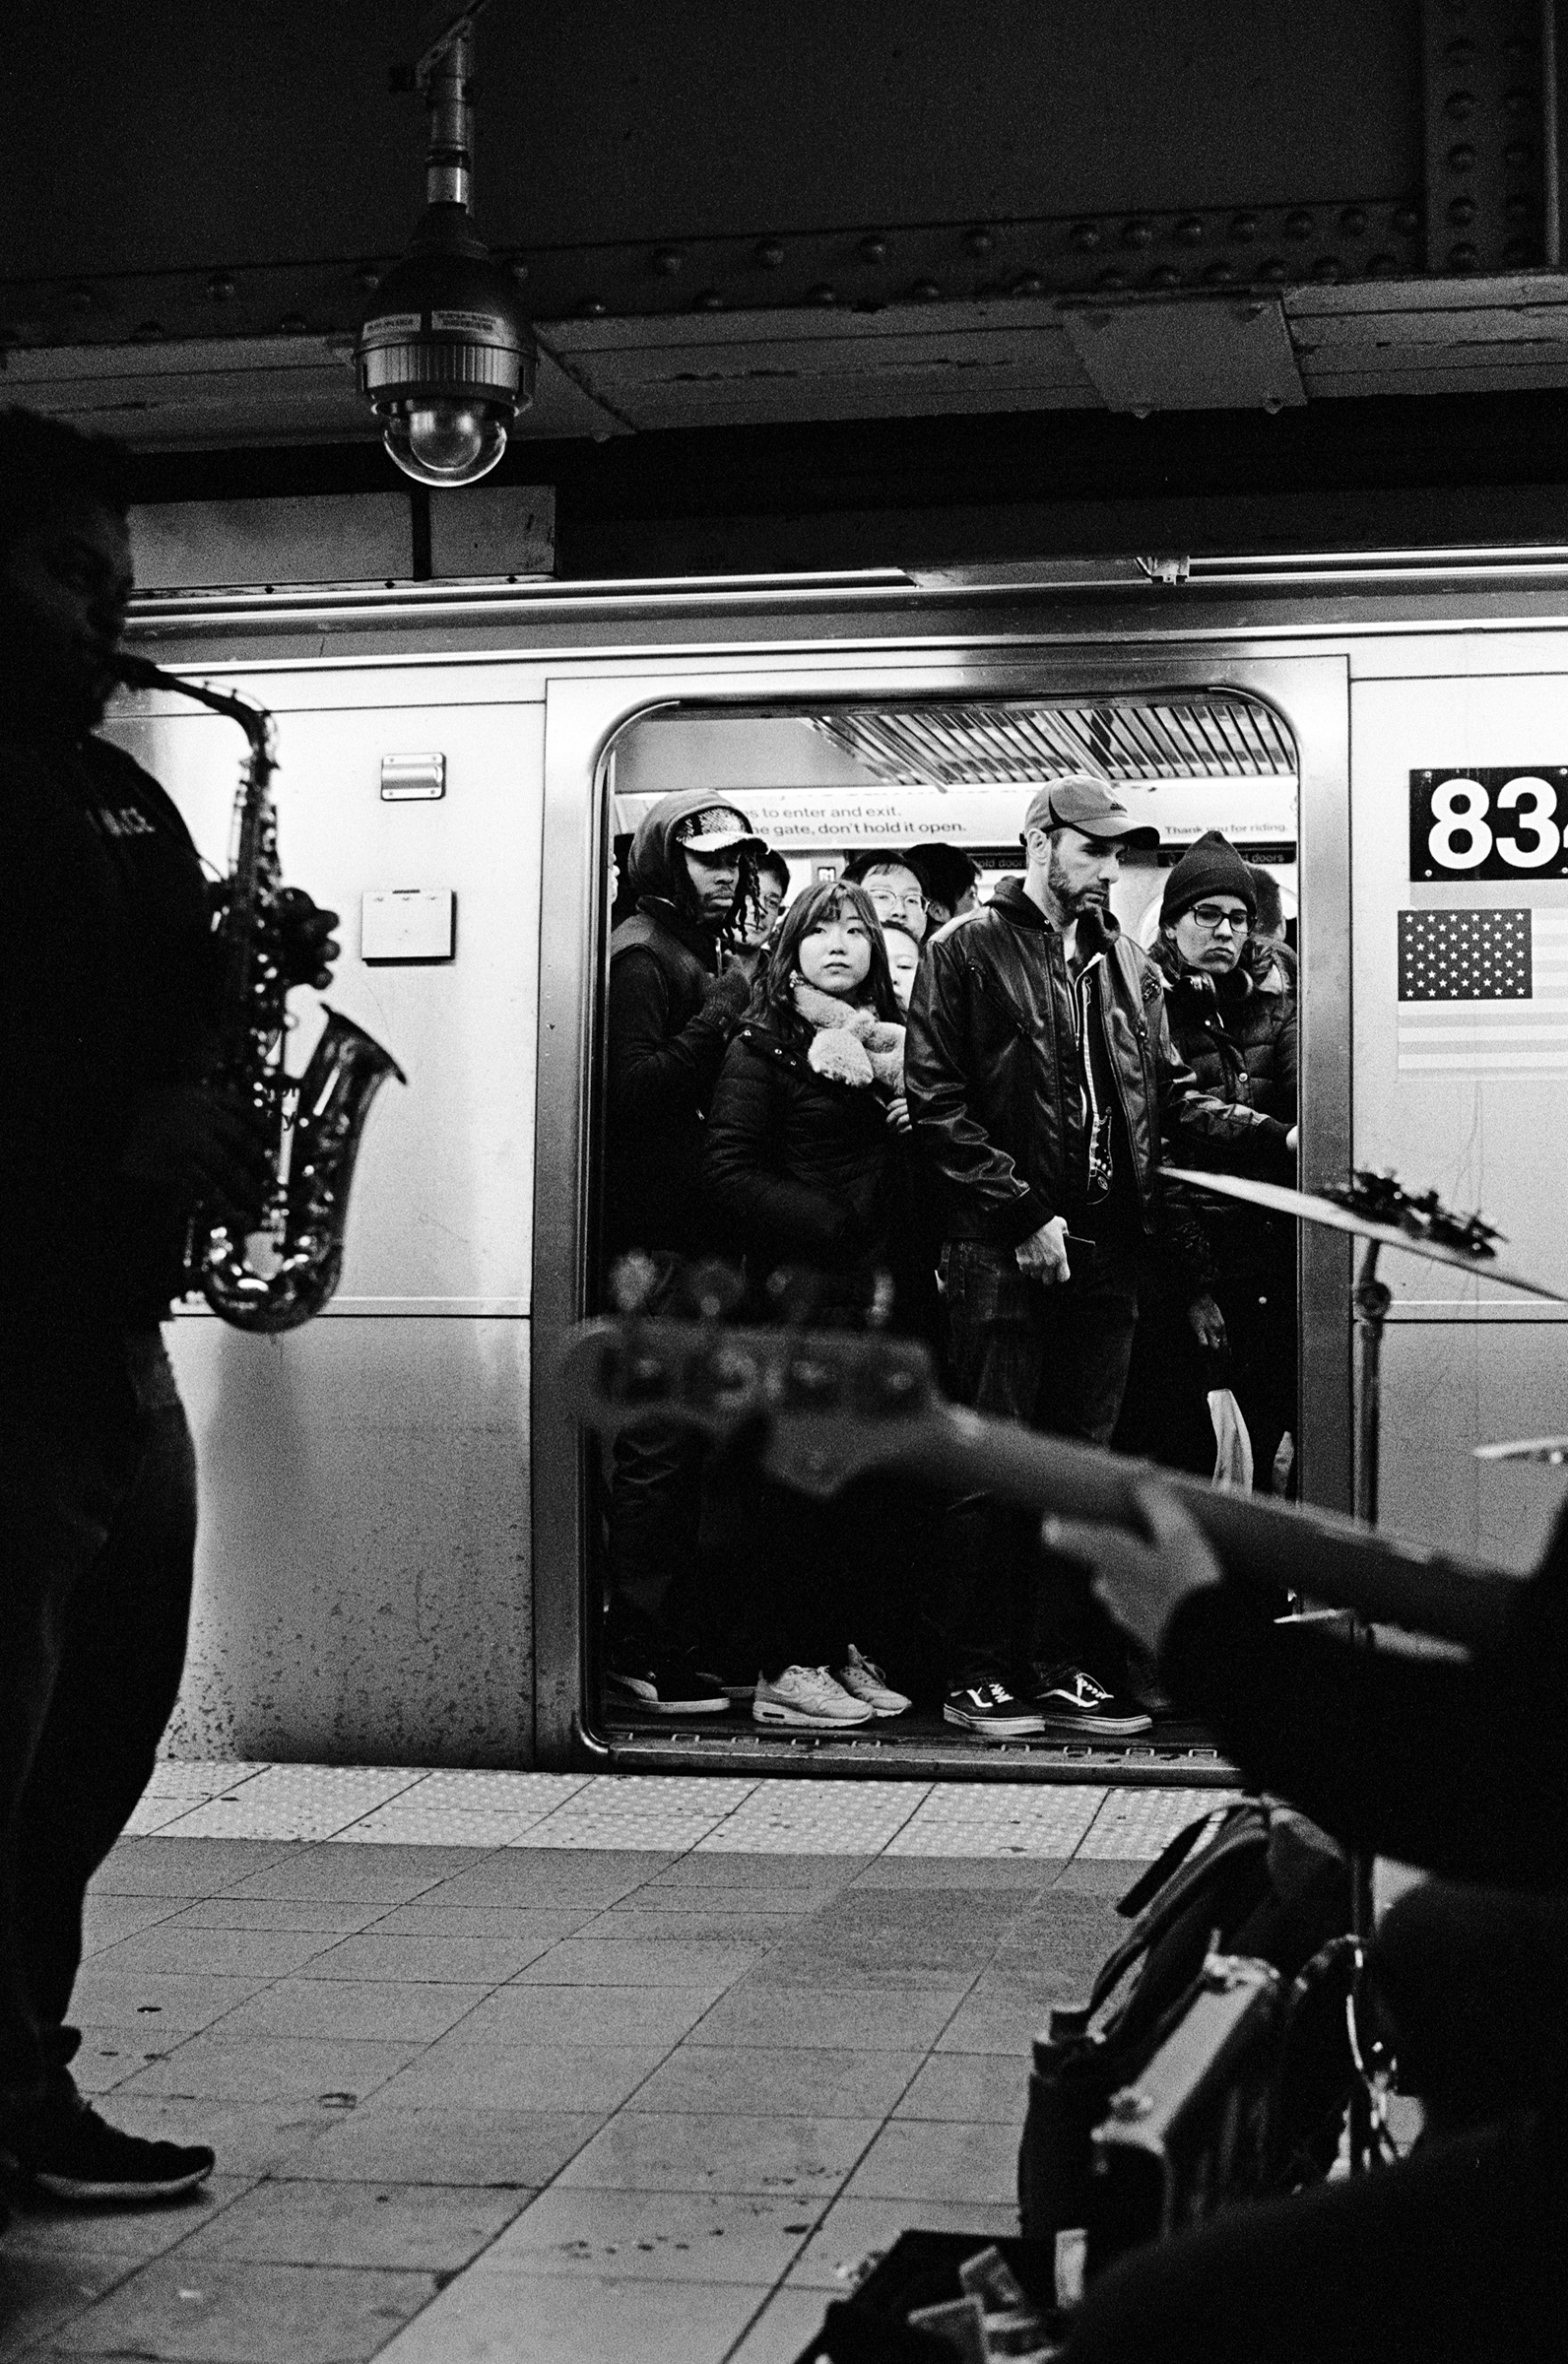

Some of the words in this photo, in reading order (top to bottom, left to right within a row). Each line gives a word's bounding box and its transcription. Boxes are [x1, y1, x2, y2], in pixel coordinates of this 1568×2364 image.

[762, 808, 779, 818] to
[783, 808, 825, 818] enter
[830, 807, 862, 818] and
[866, 806, 901, 817] exit.
[773, 824, 816, 836] gate,
[817, 822, 861, 834] don't
[864, 821, 901, 833] hold
[904, 821, 914, 832] it
[918, 822, 966, 834] open.
[1164, 825, 1203, 834] Thank
[1230, 824, 1247, 833] for
[1428, 776, 1568, 870] 83
